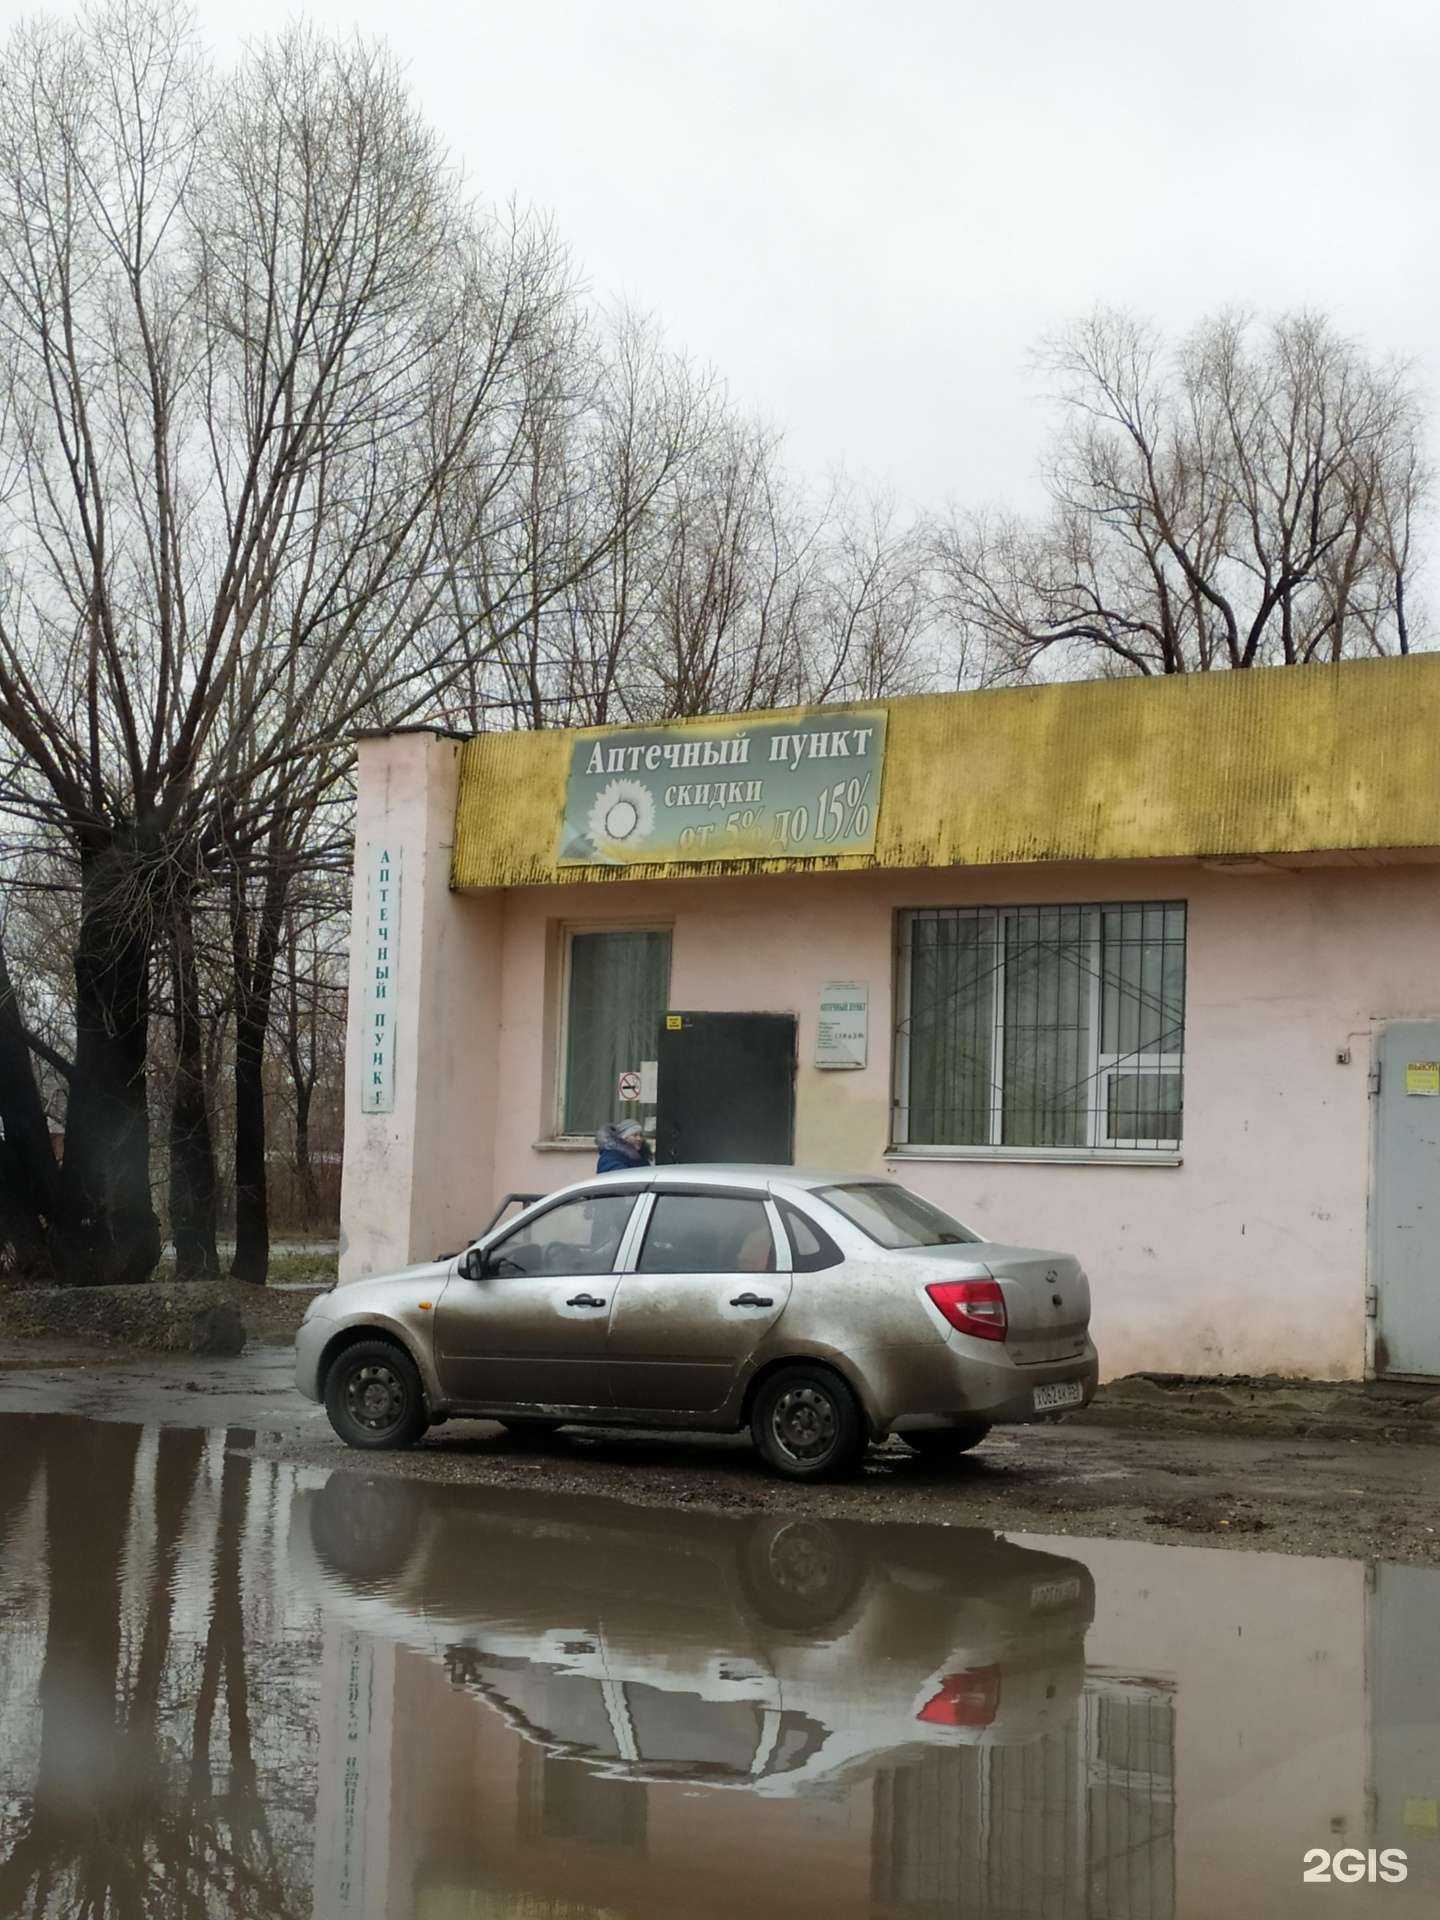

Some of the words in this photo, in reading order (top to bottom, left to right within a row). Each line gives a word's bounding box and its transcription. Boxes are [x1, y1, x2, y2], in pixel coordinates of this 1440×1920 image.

[586, 733, 751, 775] Аптечный
[768, 727, 873, 770] пункт
[664, 780, 763, 809] скидки
[679, 823, 716, 850] от
[770, 806, 809, 851] до
[814, 771, 872, 843] 15%
[375, 850, 390, 998] АПТЕЧНЫЙ
